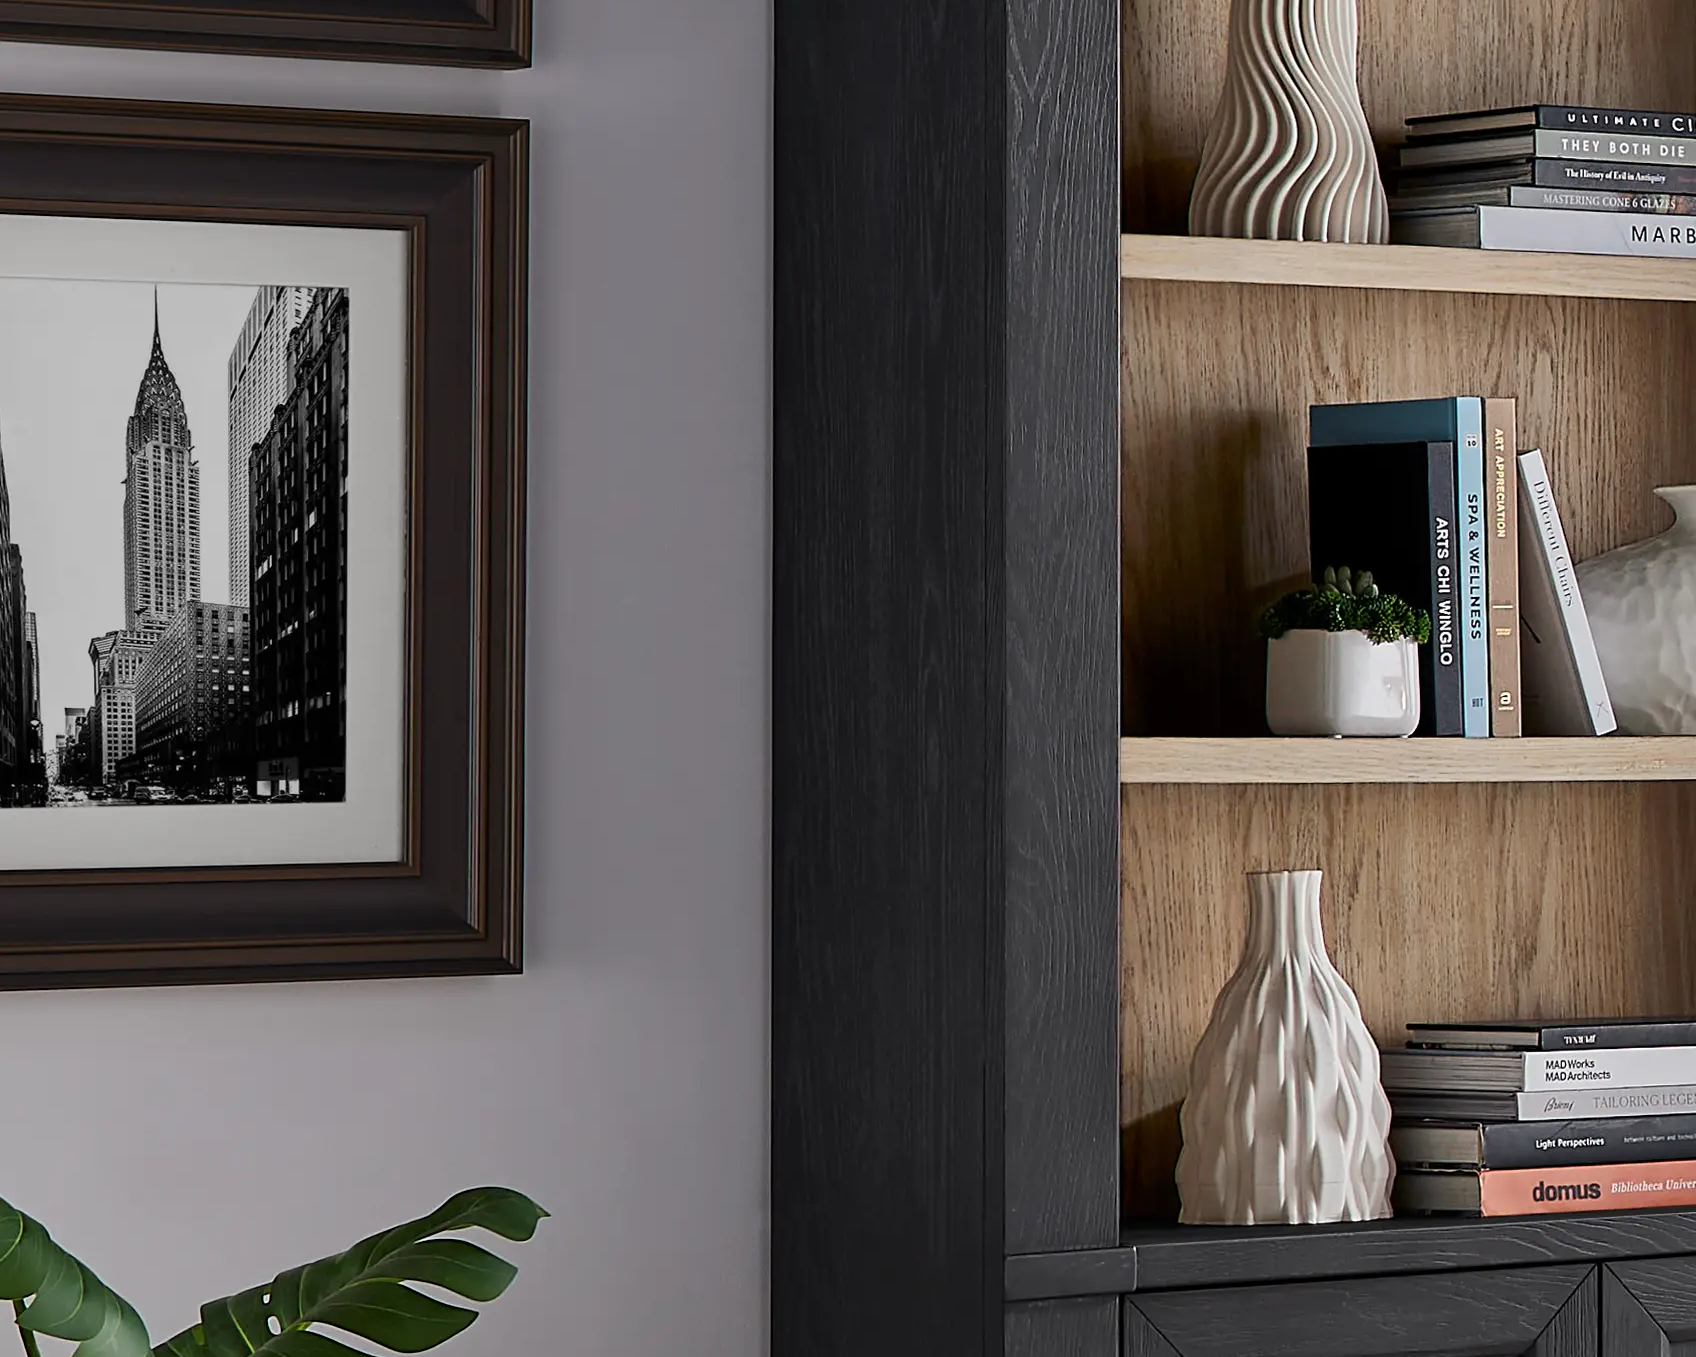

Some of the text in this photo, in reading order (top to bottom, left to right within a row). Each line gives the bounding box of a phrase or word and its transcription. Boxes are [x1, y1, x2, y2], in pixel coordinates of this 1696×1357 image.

[1567, 113, 1660, 128] ULTIMATE
[1562, 138, 1599, 152] THEY
[1609, 141, 1651, 156] BOTH
[1660, 145, 1685, 158] DIE
[1565, 167, 1579, 178] The
[1580, 169, 1604, 182] History
[1605, 170, 1612, 180] of
[1627, 172, 1635, 181] in
[1543, 193, 1676, 211] MASTERING CONE 6 GLAZES
[1495, 428, 1506, 538] ART APPRECIATION
[1534, 481, 1574, 607] Different Chairs
[1468, 494, 1481, 640] SPA & WELLNESS
[1436, 517, 1453, 667] ARTS CHI WINGLO
[1545, 1058, 1595, 1070] MAD Works
[1545, 1070, 1611, 1082] MAD Architects
[1593, 1094, 1659, 1109] TAILORING
[1535, 1140, 1556, 1150] Light
[1557, 1136, 1605, 1149] Perspectives
[1532, 1180, 1602, 1203] domus
[1611, 1181, 1664, 1194] Bibliotheca
